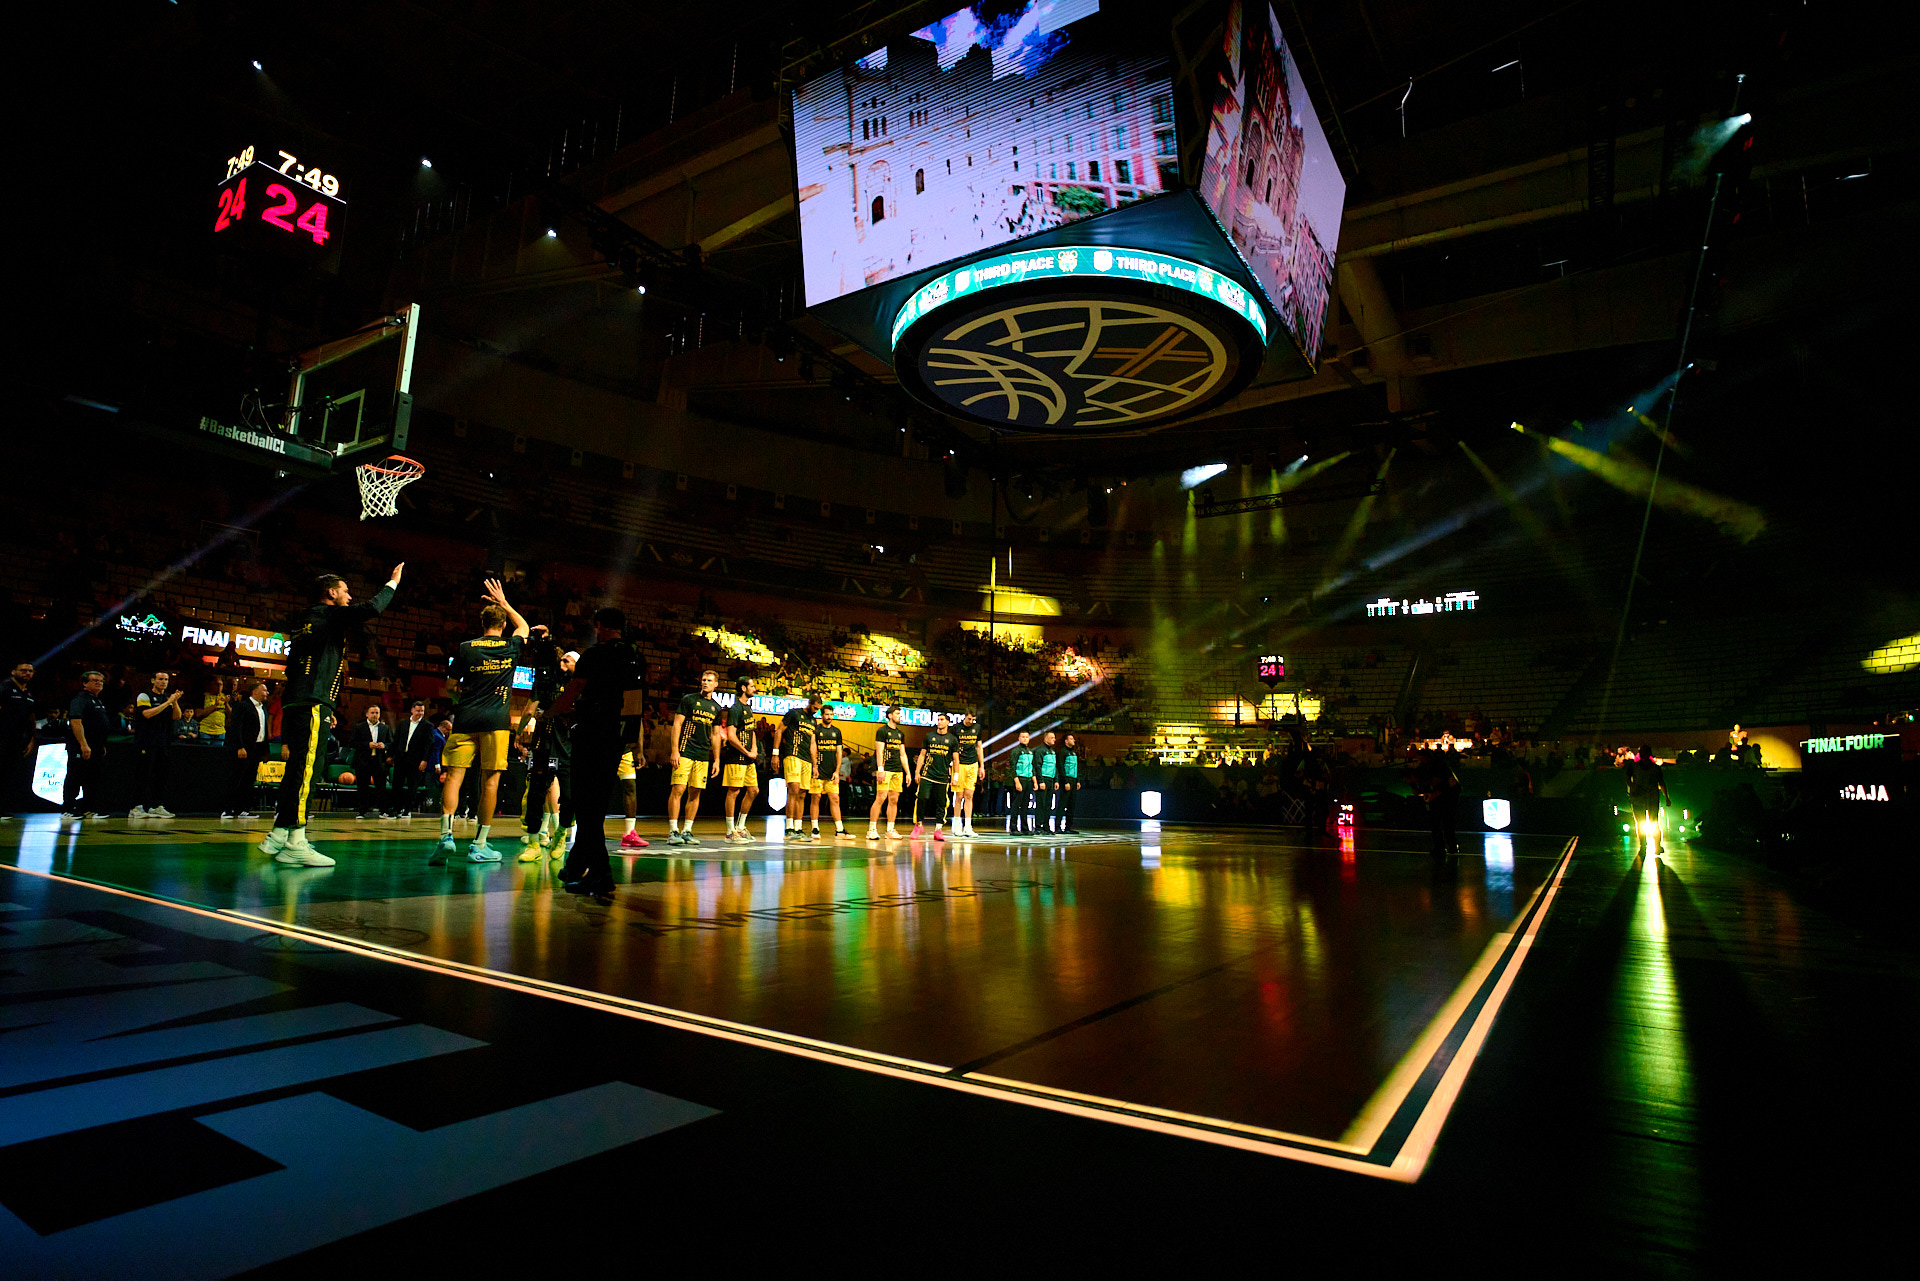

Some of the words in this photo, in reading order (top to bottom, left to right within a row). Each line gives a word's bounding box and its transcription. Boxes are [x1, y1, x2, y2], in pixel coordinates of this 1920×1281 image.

[227, 145, 254, 180] 7:49
[278, 149, 340, 197] 7:49
[214, 177, 247, 233] 24
[261, 183, 330, 245] 24
[973, 263, 1011, 282] THIRD
[1011, 256, 1055, 274] PLACE
[1115, 256, 1158, 274] THIRD
[1158, 263, 1196, 283] PLACE
[199, 416, 286, 455] #BasketballCL
[235, 633, 283, 655] FOUR
[1260, 664, 1276, 677] 24
[1807, 736, 1845, 754] FINAL
[1845, 733, 1885, 751] FOUR
[1337, 812, 1353, 825] 24
